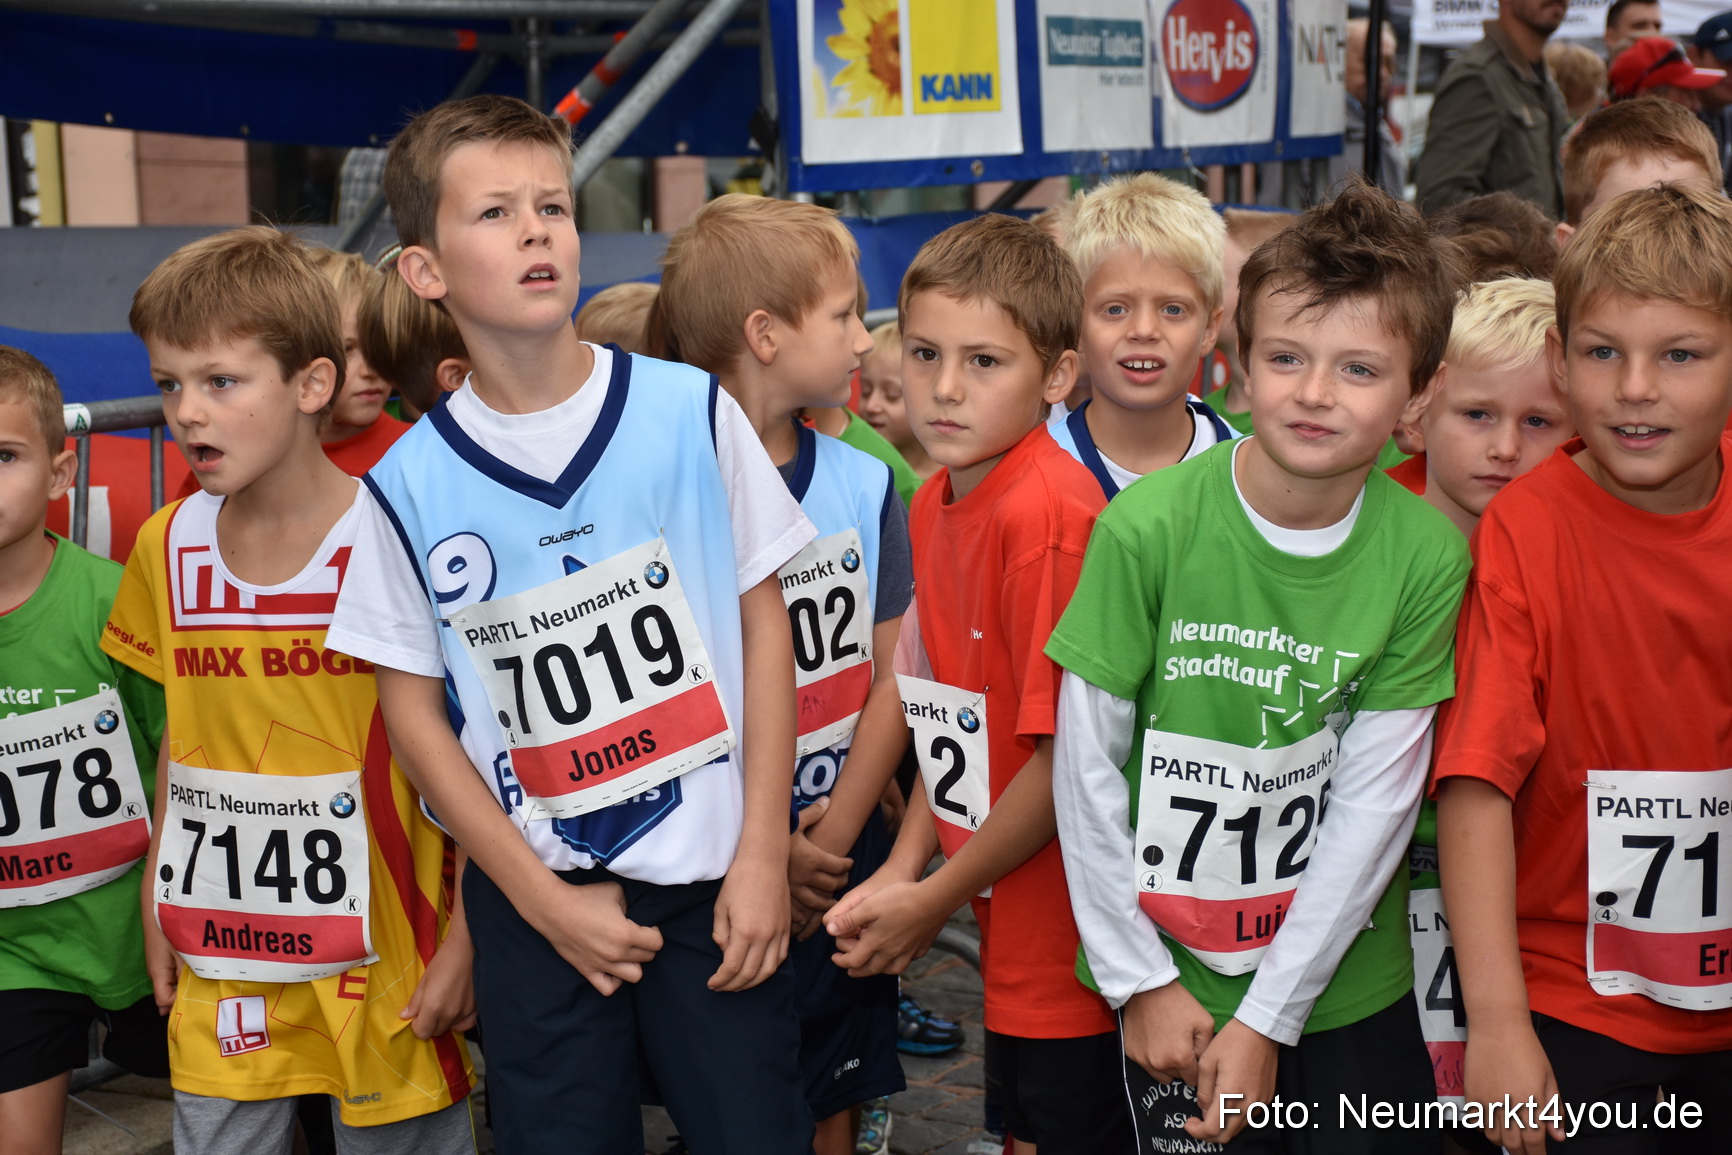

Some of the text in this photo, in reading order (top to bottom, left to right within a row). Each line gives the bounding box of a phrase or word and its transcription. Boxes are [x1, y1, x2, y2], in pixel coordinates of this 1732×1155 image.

[1168, 15, 1253, 83] Hervis
[921, 73, 992, 102] KANN
[464, 577, 640, 648] PARTL Neumarkt
[1170, 618, 1324, 665] Neumarkter
[173, 647, 248, 677] MAX
[493, 604, 685, 735] 7019
[691, 667, 702, 681] K
[1164, 653, 1292, 695] Stadtlauf
[568, 728, 657, 782] Jonas
[1150, 748, 1333, 793] PARTL Neumarkt
[171, 783, 320, 817] PARTL Neumarkt
[1596, 796, 1732, 819] PARTL Ne
[0, 852, 73, 882] Marc
[182, 818, 347, 904] 7148
[163, 888, 170, 901] 4
[1146, 874, 1156, 889] 4
[349, 899, 357, 911] K
[1602, 909, 1611, 921] 4
[202, 919, 313, 956] Andreas
[1236, 904, 1288, 943] Lui
[1699, 943, 1732, 977] Er
[1141, 1081, 1198, 1117] JUDOTE
[1164, 1112, 1192, 1128] AS
